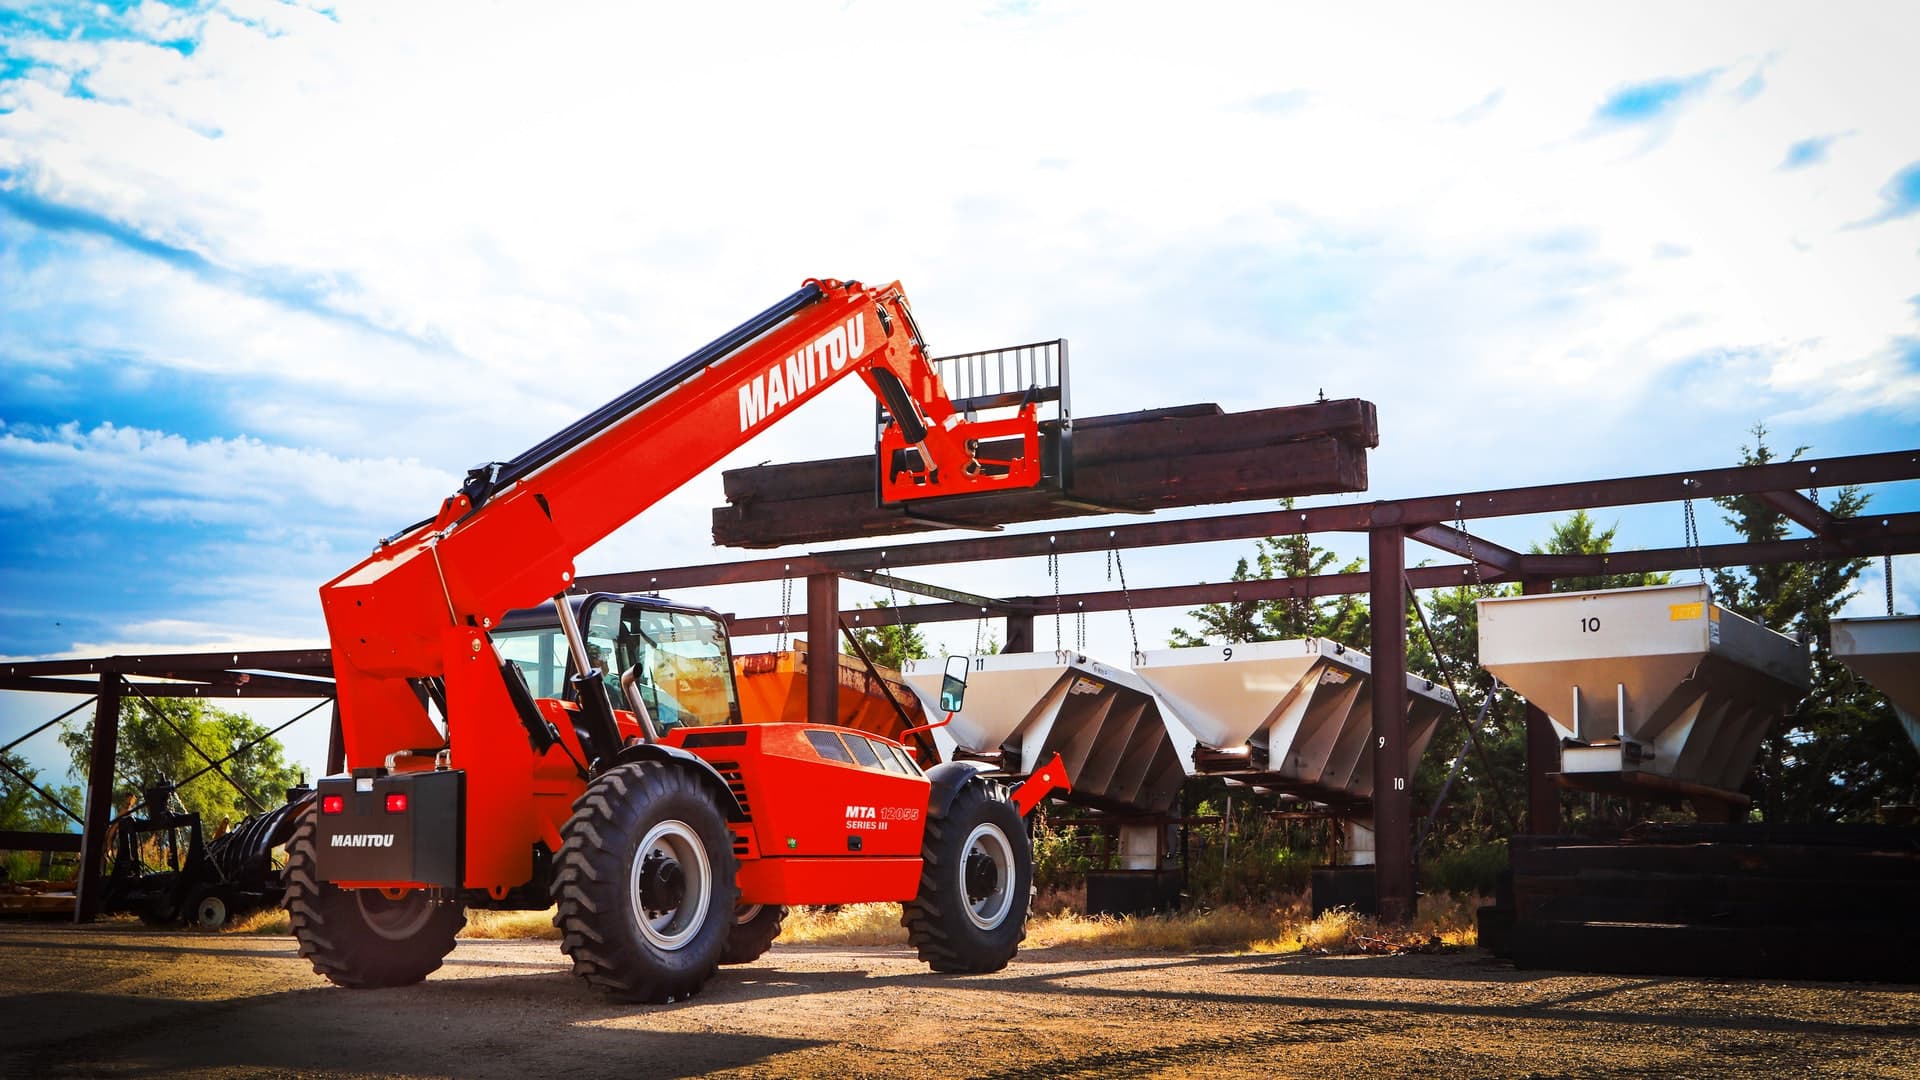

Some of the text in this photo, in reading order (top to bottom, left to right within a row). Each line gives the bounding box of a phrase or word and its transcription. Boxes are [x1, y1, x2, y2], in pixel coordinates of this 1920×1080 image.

[738, 311, 865, 433] MANITOU
[1581, 617, 1600, 632] 10
[1223, 648, 1232, 661] 9
[976, 658, 984, 671] 11
[1379, 736, 1385, 748] 9
[1394, 777, 1404, 790] 10
[845, 806, 919, 820] MTA 12055
[846, 821, 888, 830] SERIES III
[331, 834, 394, 847] MANITOU
